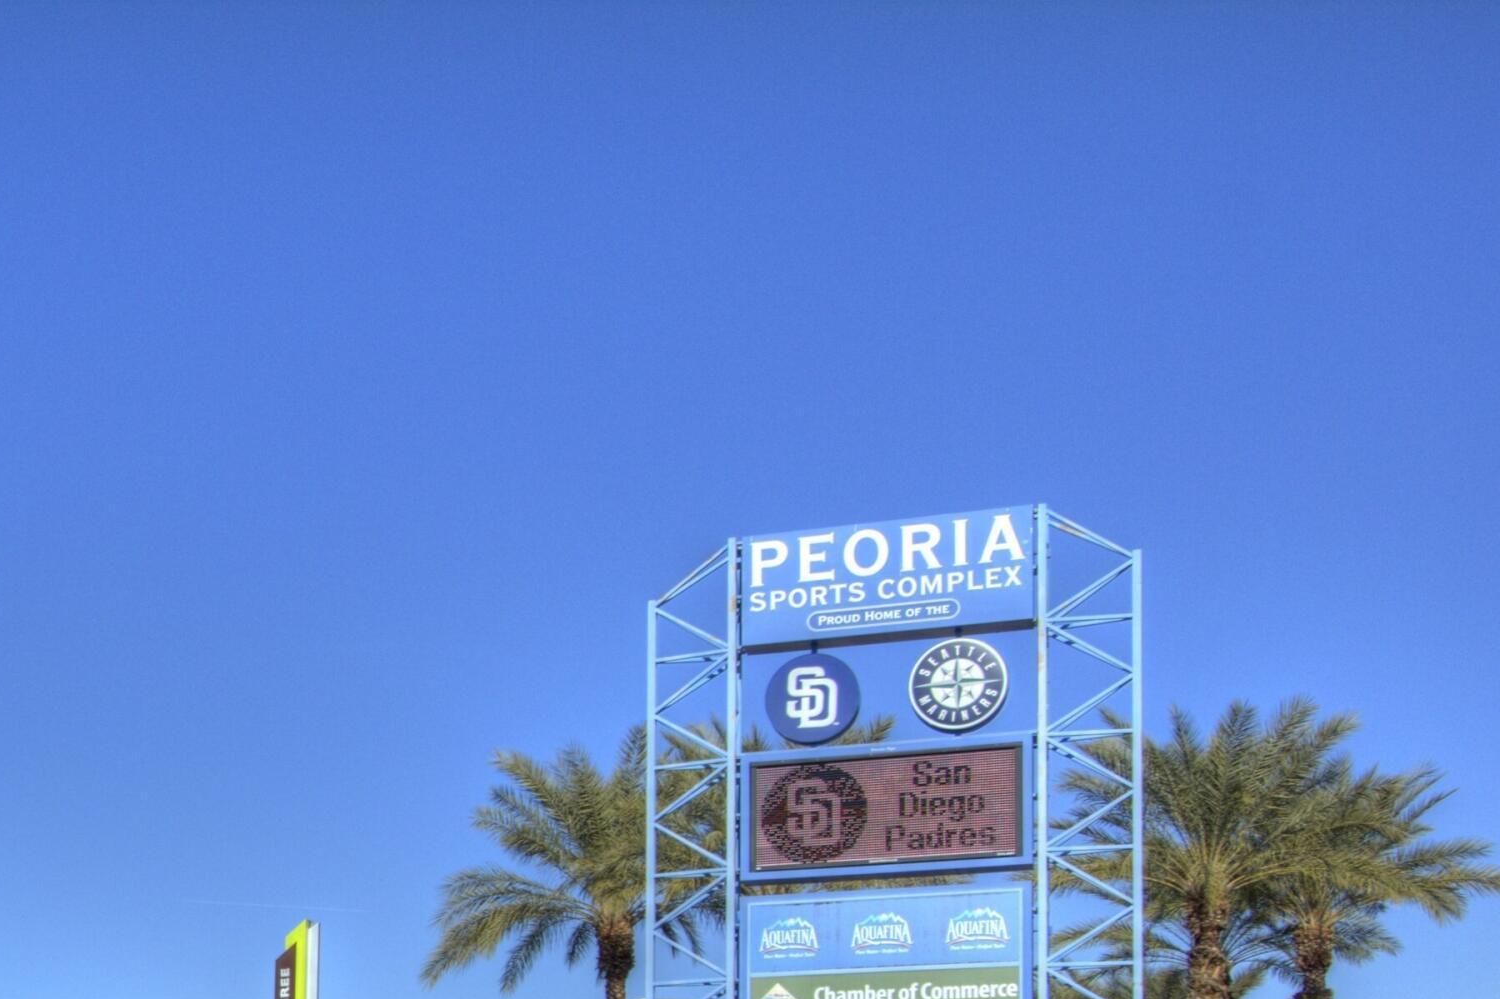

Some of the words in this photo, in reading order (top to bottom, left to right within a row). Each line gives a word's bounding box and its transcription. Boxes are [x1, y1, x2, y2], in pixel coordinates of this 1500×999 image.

[750, 514, 1026, 587] PEORIA
[749, 582, 866, 613] SPORTS
[877, 565, 1022, 600] COMPLEX
[818, 613, 861, 627] PROUD
[864, 608, 901, 623] HOME
[905, 606, 923, 618] OF
[926, 603, 950, 616] THE
[918, 644, 998, 677] SEATTLE
[786, 666, 839, 729] SD
[918, 687, 998, 723] MARINERS
[912, 760, 972, 787] San
[899, 791, 986, 822] Diego
[885, 822, 997, 852] Padres
[759, 928, 819, 954] AQUAFINA
[851, 921, 913, 949] AQUAFINA
[945, 916, 1011, 945] AQUAFINA
